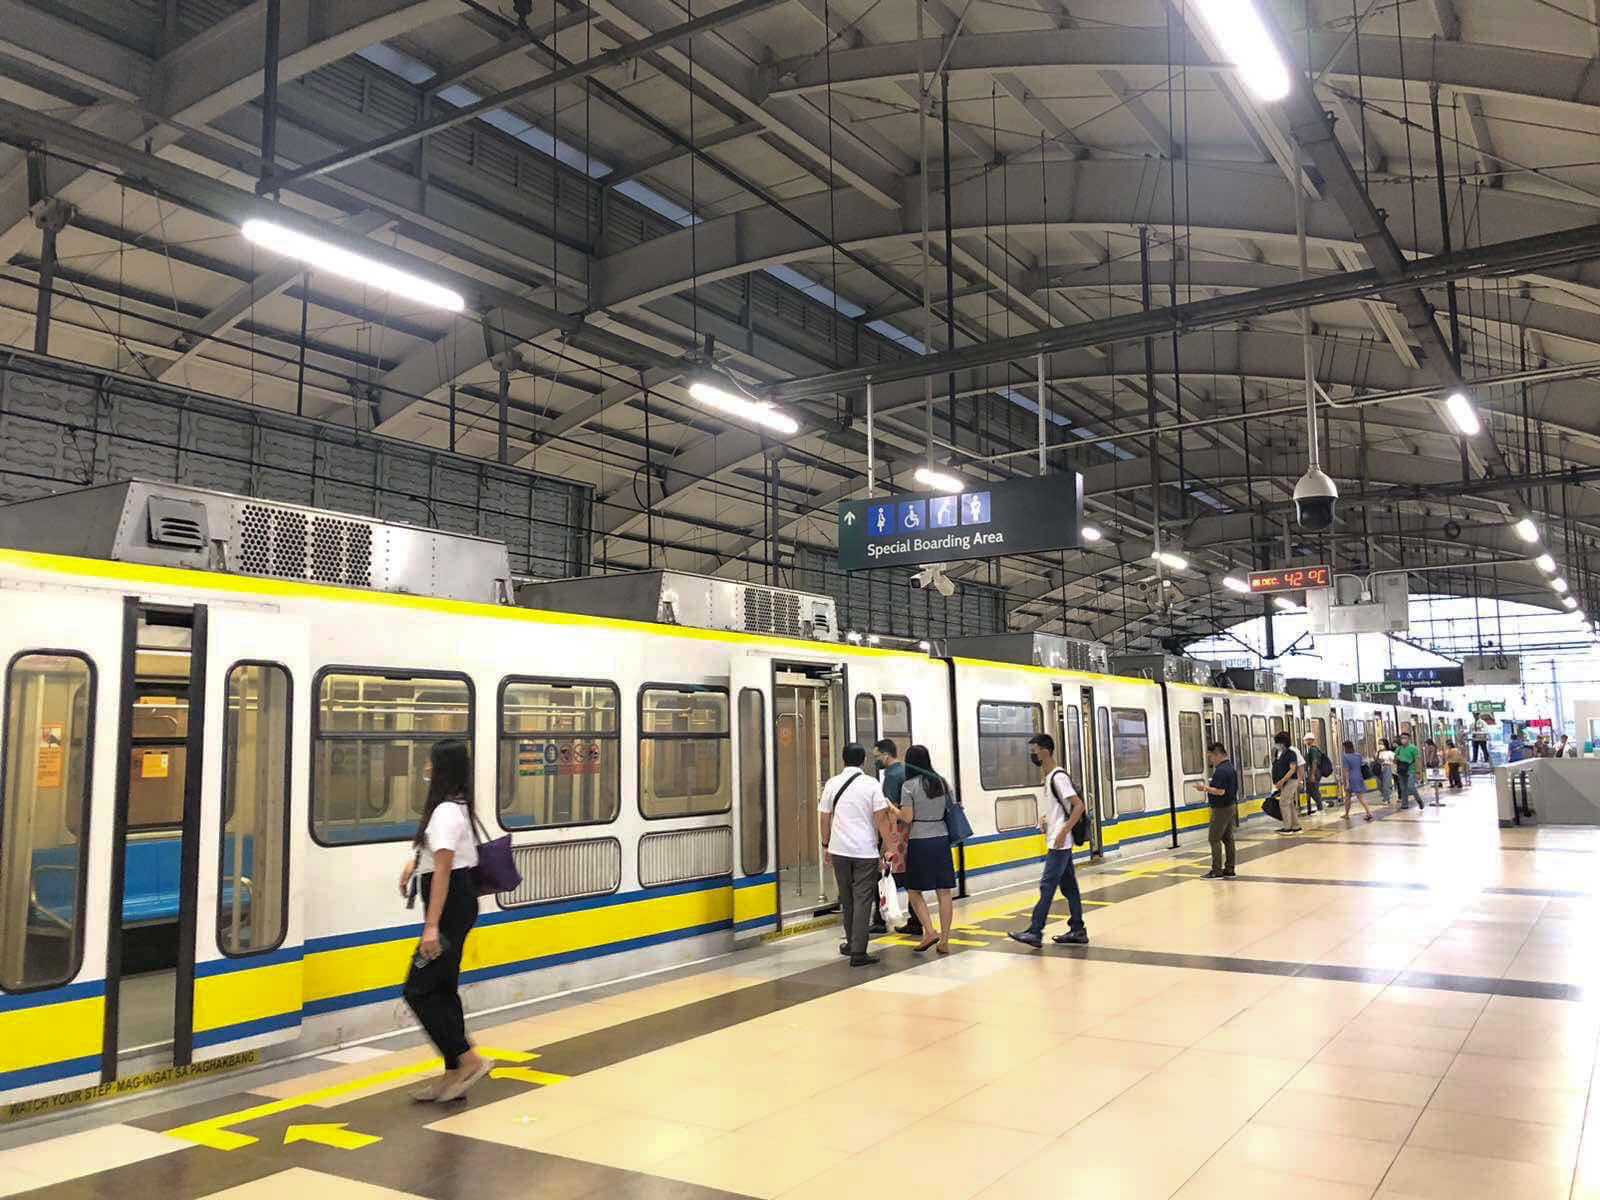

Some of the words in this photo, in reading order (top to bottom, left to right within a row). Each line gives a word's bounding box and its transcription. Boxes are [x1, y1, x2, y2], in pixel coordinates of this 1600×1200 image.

[867, 539, 911, 559] Special
[914, 534, 970, 551] Boarding
[973, 532, 1004, 545] Area
[1284, 571, 1303, 586] 42
[1356, 682, 1381, 693] EXIT
[8, 1097, 50, 1116] WATCH
[51, 1090, 82, 1107] YOUR
[84, 1081, 112, 1100] STEP
[115, 1068, 174, 1091] MAG-INGAT
[175, 1067, 189, 1079] SA
[190, 1051, 254, 1076] PAGHAKBANG
